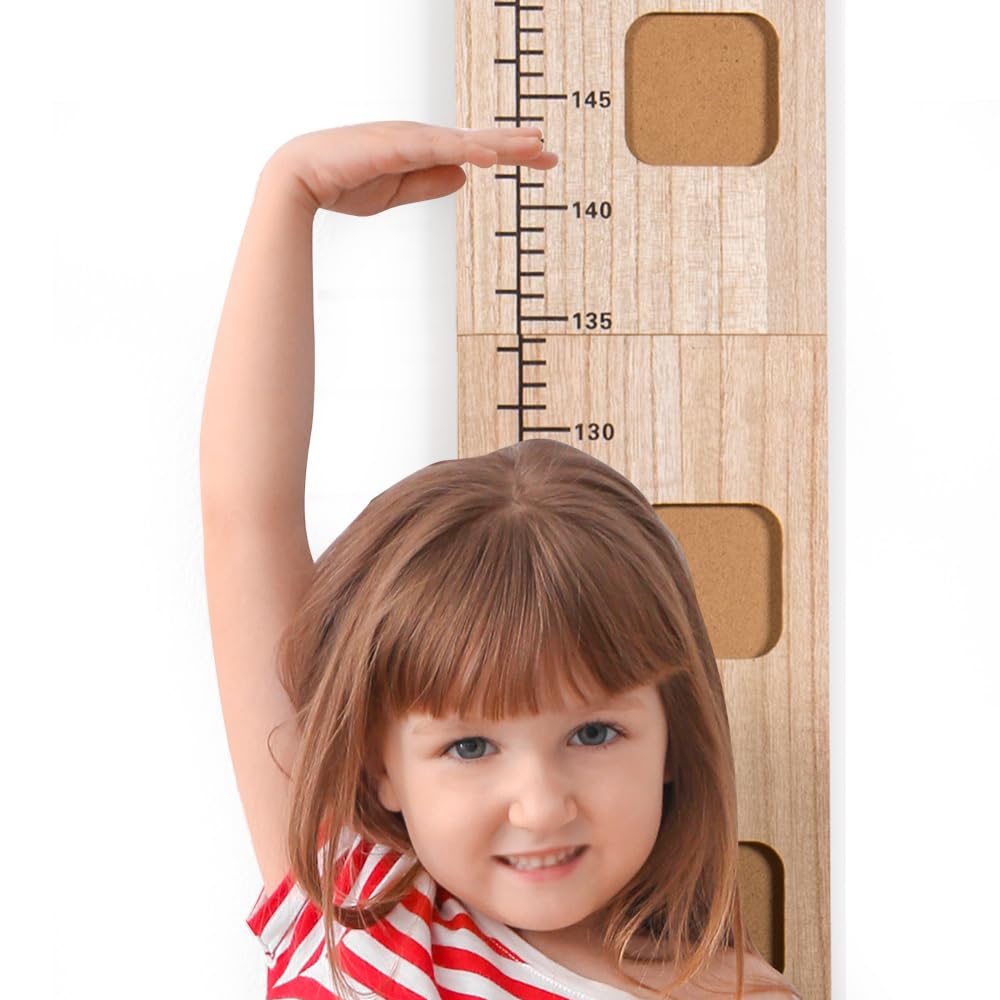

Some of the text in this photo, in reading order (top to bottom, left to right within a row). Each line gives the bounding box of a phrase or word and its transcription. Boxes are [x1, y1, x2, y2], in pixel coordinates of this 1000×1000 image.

[572, 90, 611, 109] 145
[572, 201, 612, 219] 140
[572, 311, 612, 330] 135
[575, 422, 615, 441] 130
